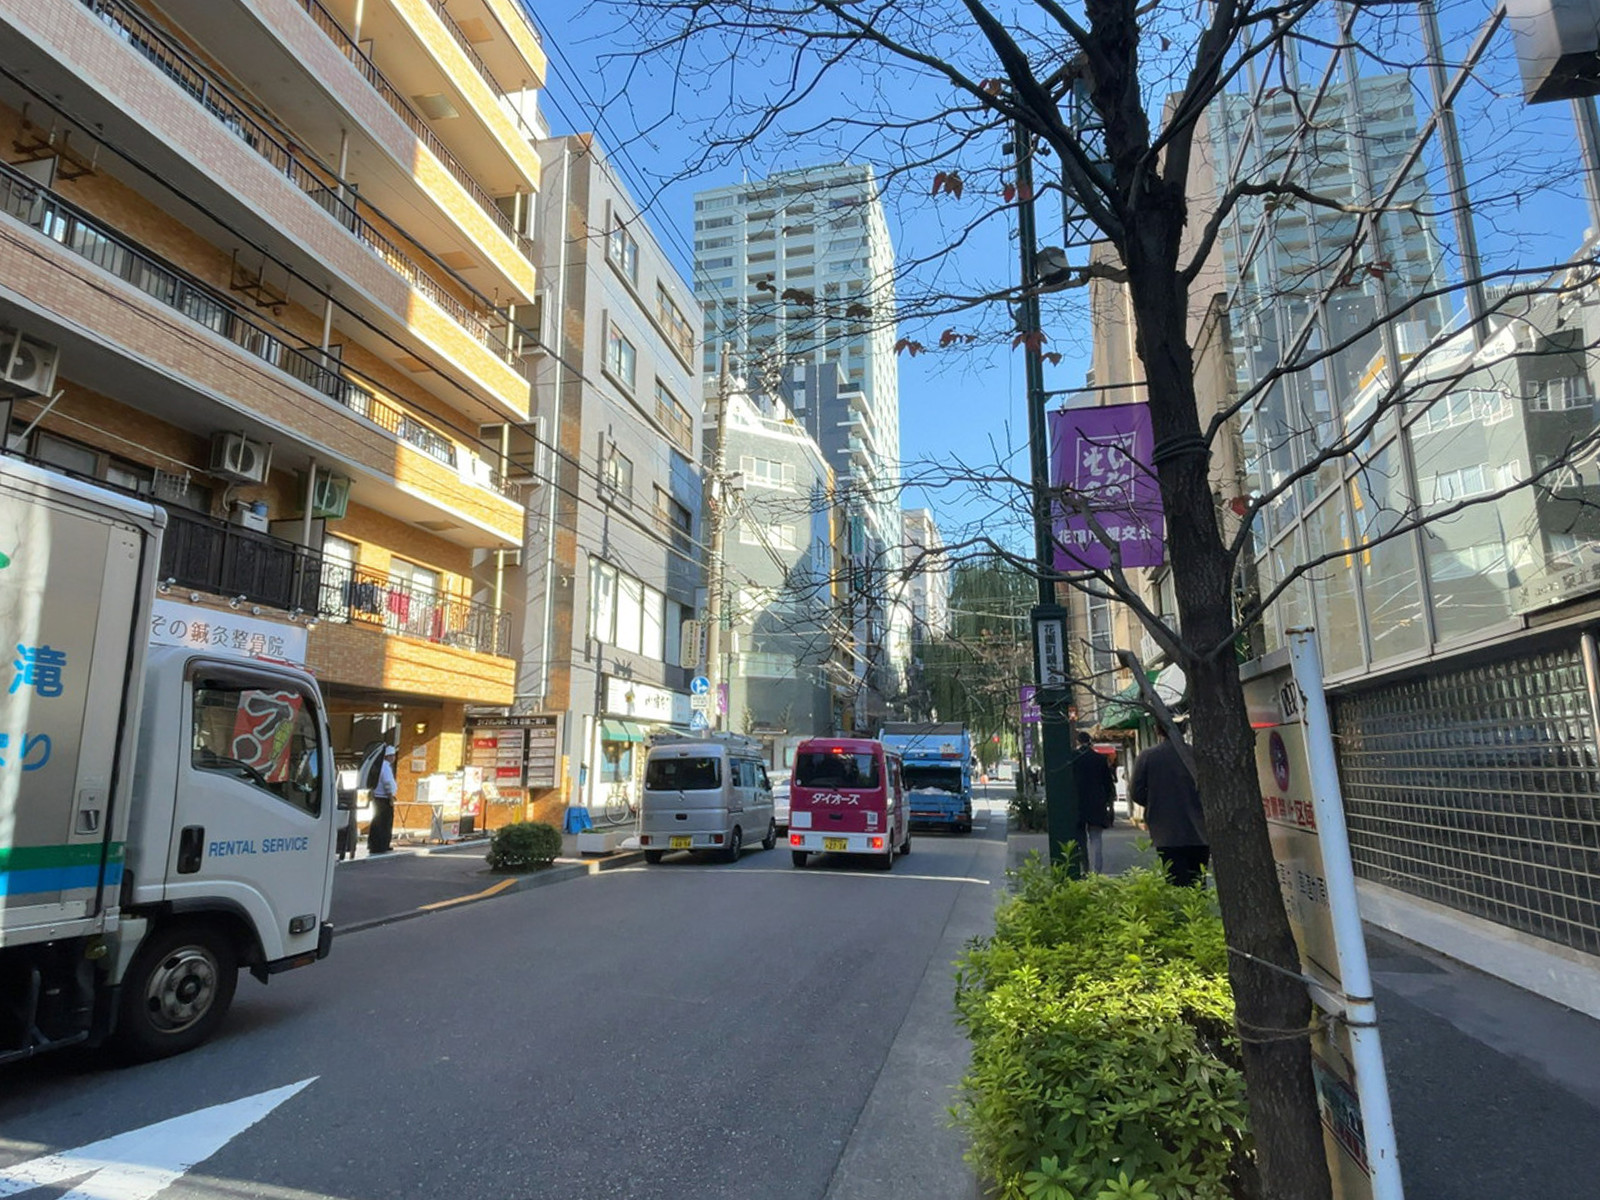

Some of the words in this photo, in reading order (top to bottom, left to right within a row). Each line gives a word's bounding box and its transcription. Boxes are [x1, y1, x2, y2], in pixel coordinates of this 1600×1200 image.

[8, 643, 67, 698] 滝
[811, 792, 861, 805] ダイオーズ
[208, 839, 257, 857] RENTAL
[261, 837, 309, 854] SERVICE
